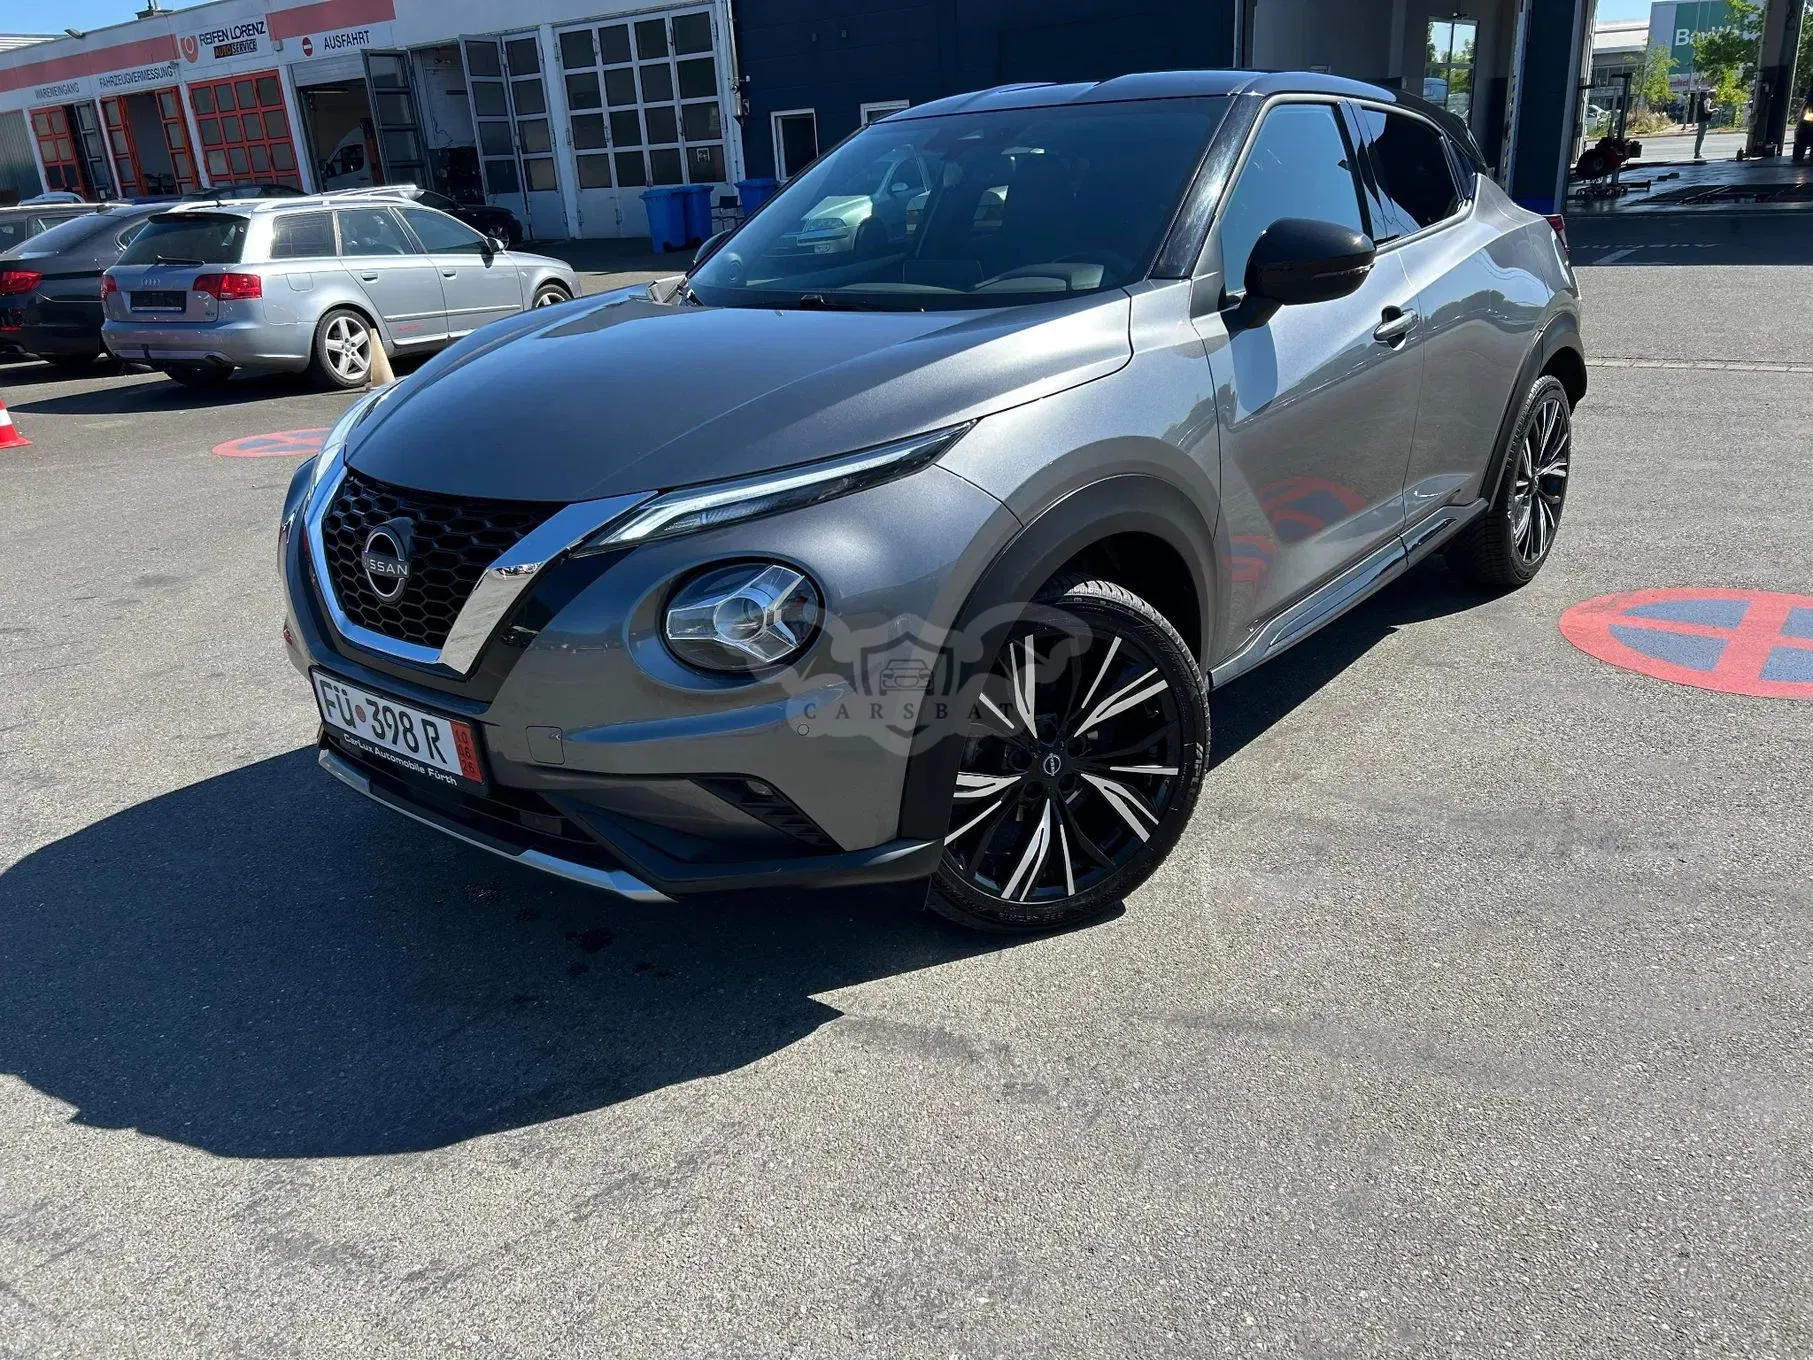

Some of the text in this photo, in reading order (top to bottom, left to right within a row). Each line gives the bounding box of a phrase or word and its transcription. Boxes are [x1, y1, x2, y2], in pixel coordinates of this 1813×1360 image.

[199, 21, 266, 47] REIFEN LORENZ
[324, 30, 371, 50] AUSFAHRT
[99, 65, 174, 89] FAHRZEUGVERMESSUNG
[365, 698, 420, 753] 398
[421, 718, 448, 765] R
[374, 747, 425, 774] Automobile
[427, 767, 458, 787] Fürth
